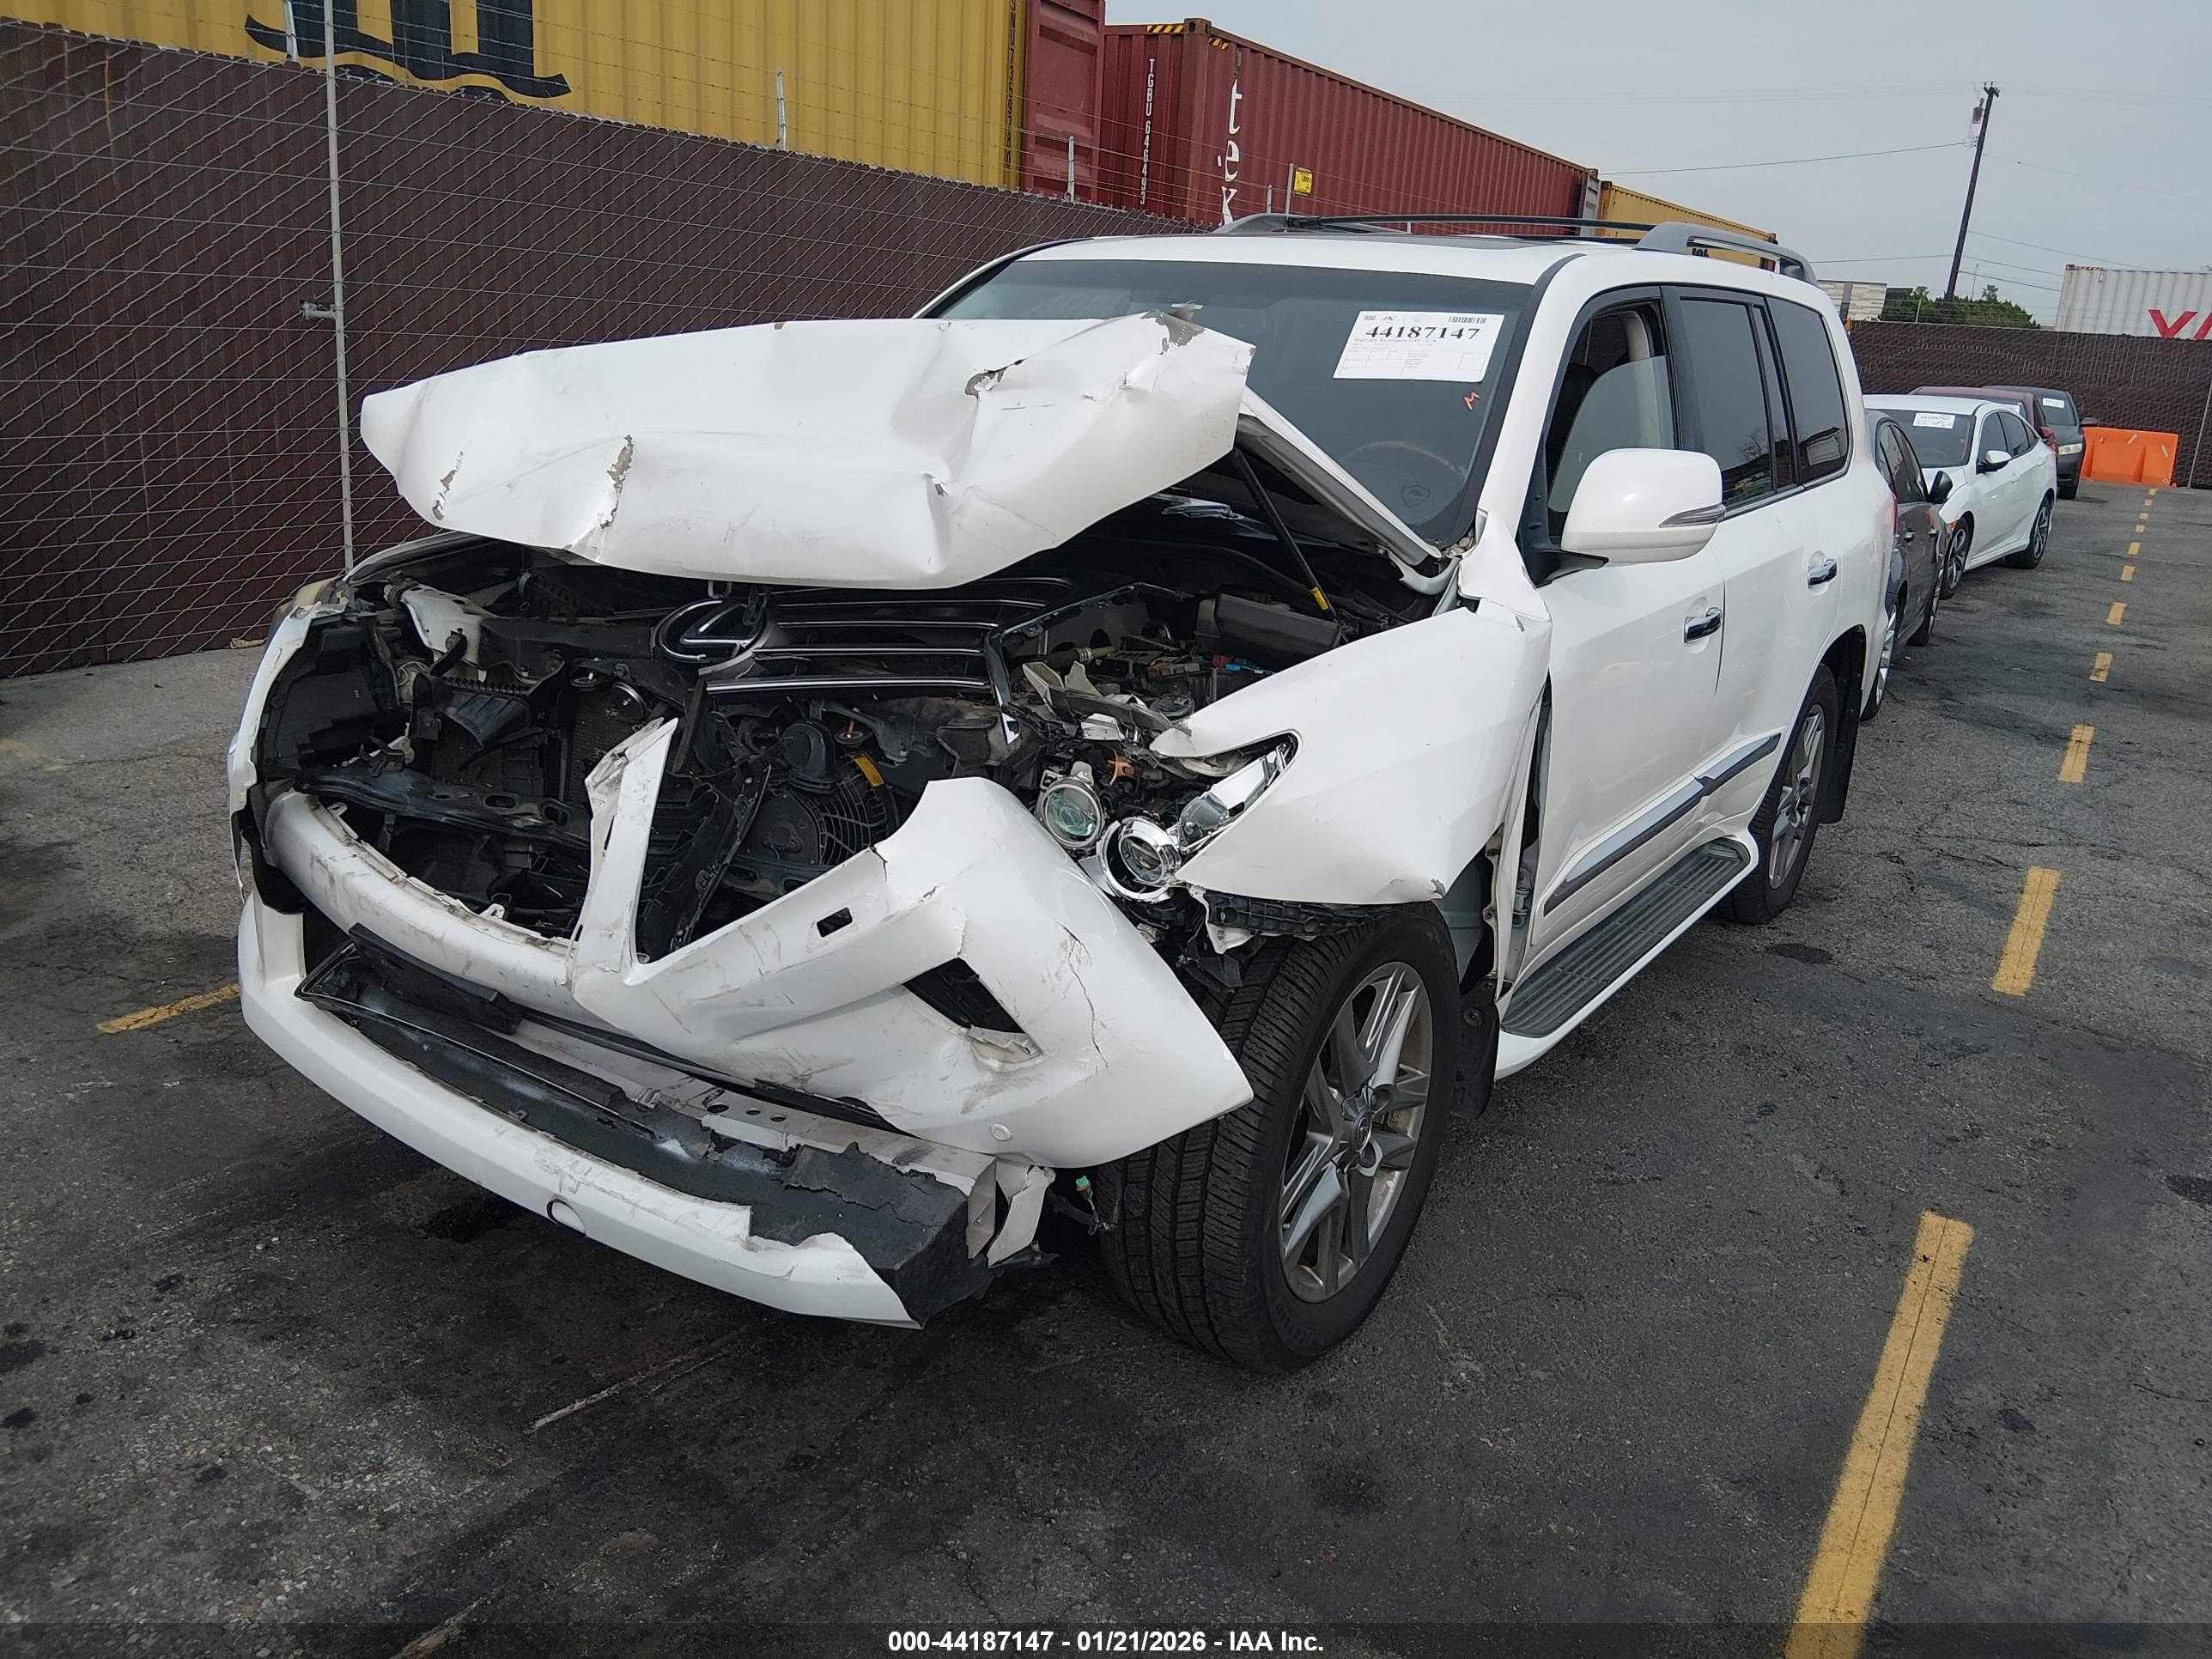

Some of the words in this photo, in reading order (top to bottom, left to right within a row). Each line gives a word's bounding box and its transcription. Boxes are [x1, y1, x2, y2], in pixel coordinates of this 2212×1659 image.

[1146, 58, 1155, 117] TGBU
[1139, 120, 1152, 205] 646493
[1365, 325, 1481, 340] 44187147
